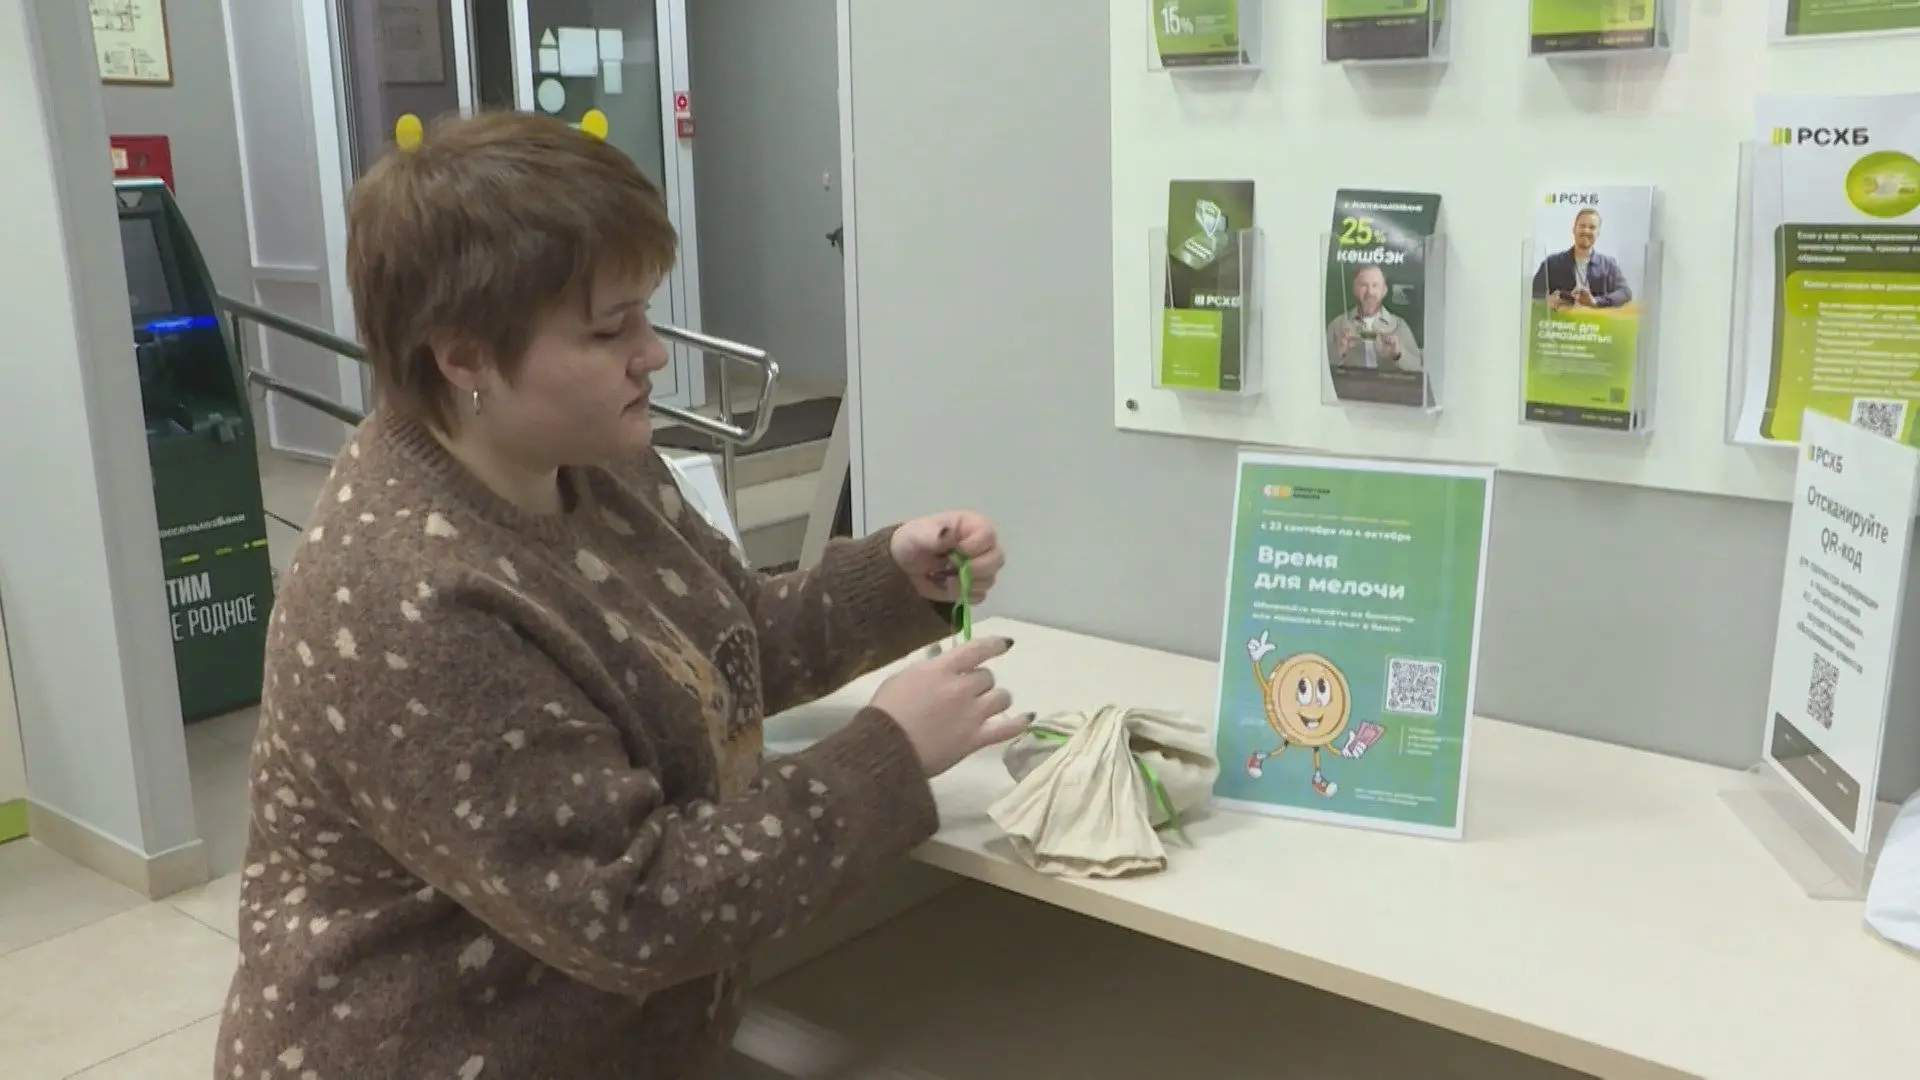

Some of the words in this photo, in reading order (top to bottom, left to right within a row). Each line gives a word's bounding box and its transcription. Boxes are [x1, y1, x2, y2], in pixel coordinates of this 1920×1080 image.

[1161, 6, 1194, 35] 15%
[1797, 127, 1870, 146] РСХБ
[1559, 192, 1599, 205] РСХБ
[1337, 247, 1405, 264] кешбэк
[1816, 446, 1844, 473] РСХБ
[1807, 484, 1889, 543] Отсканируйте
[1285, 524, 1336, 537] сентября
[1365, 529, 1412, 543] октября
[1258, 545, 1339, 569] Время
[1821, 527, 1863, 573] QR-код
[166, 572, 211, 607] ТИМ
[1254, 572, 1301, 591] для
[1309, 577, 1405, 600] мелочи
[188, 594, 257, 637] РОДНОЕ
